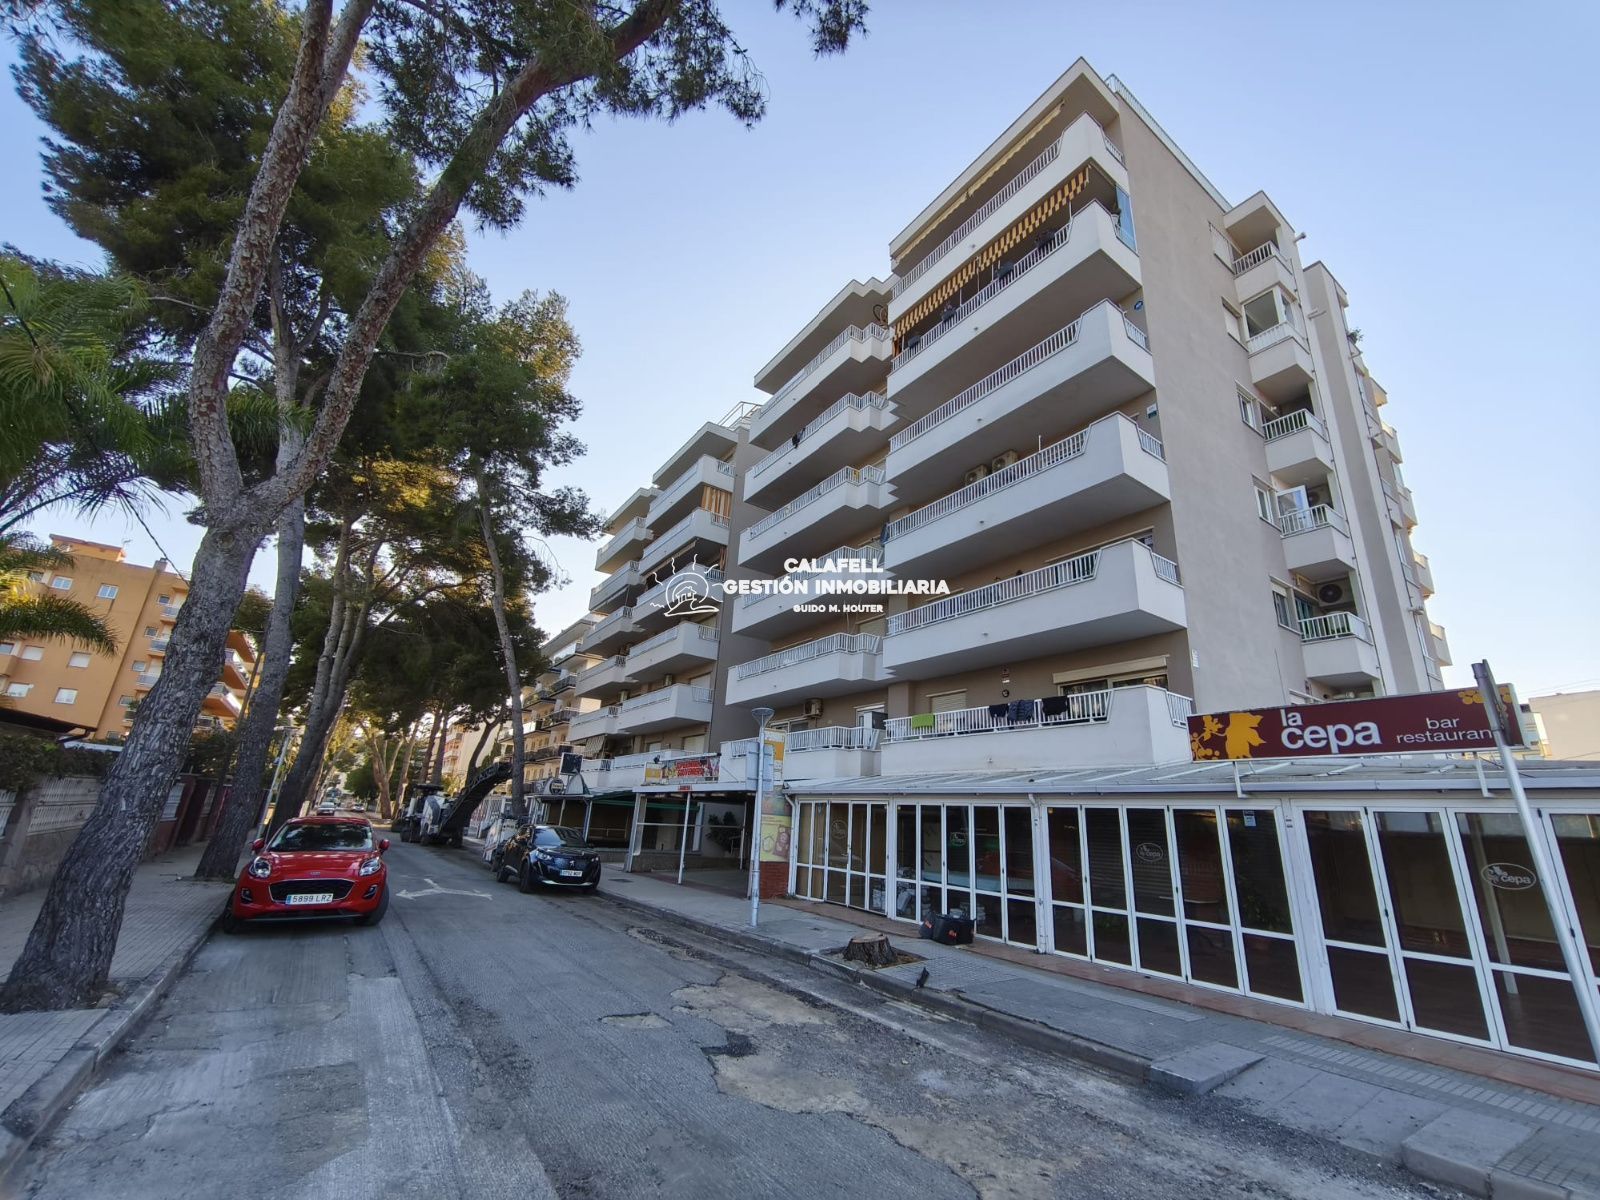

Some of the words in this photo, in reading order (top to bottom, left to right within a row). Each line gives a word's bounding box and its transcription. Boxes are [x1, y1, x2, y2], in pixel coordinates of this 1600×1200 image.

[1280, 708, 1303, 727] la
[1426, 717, 1460, 730] bar
[1281, 721, 1383, 754] cepa
[1396, 727, 1493, 744] restauran
[1500, 874, 1532, 886] cepa
